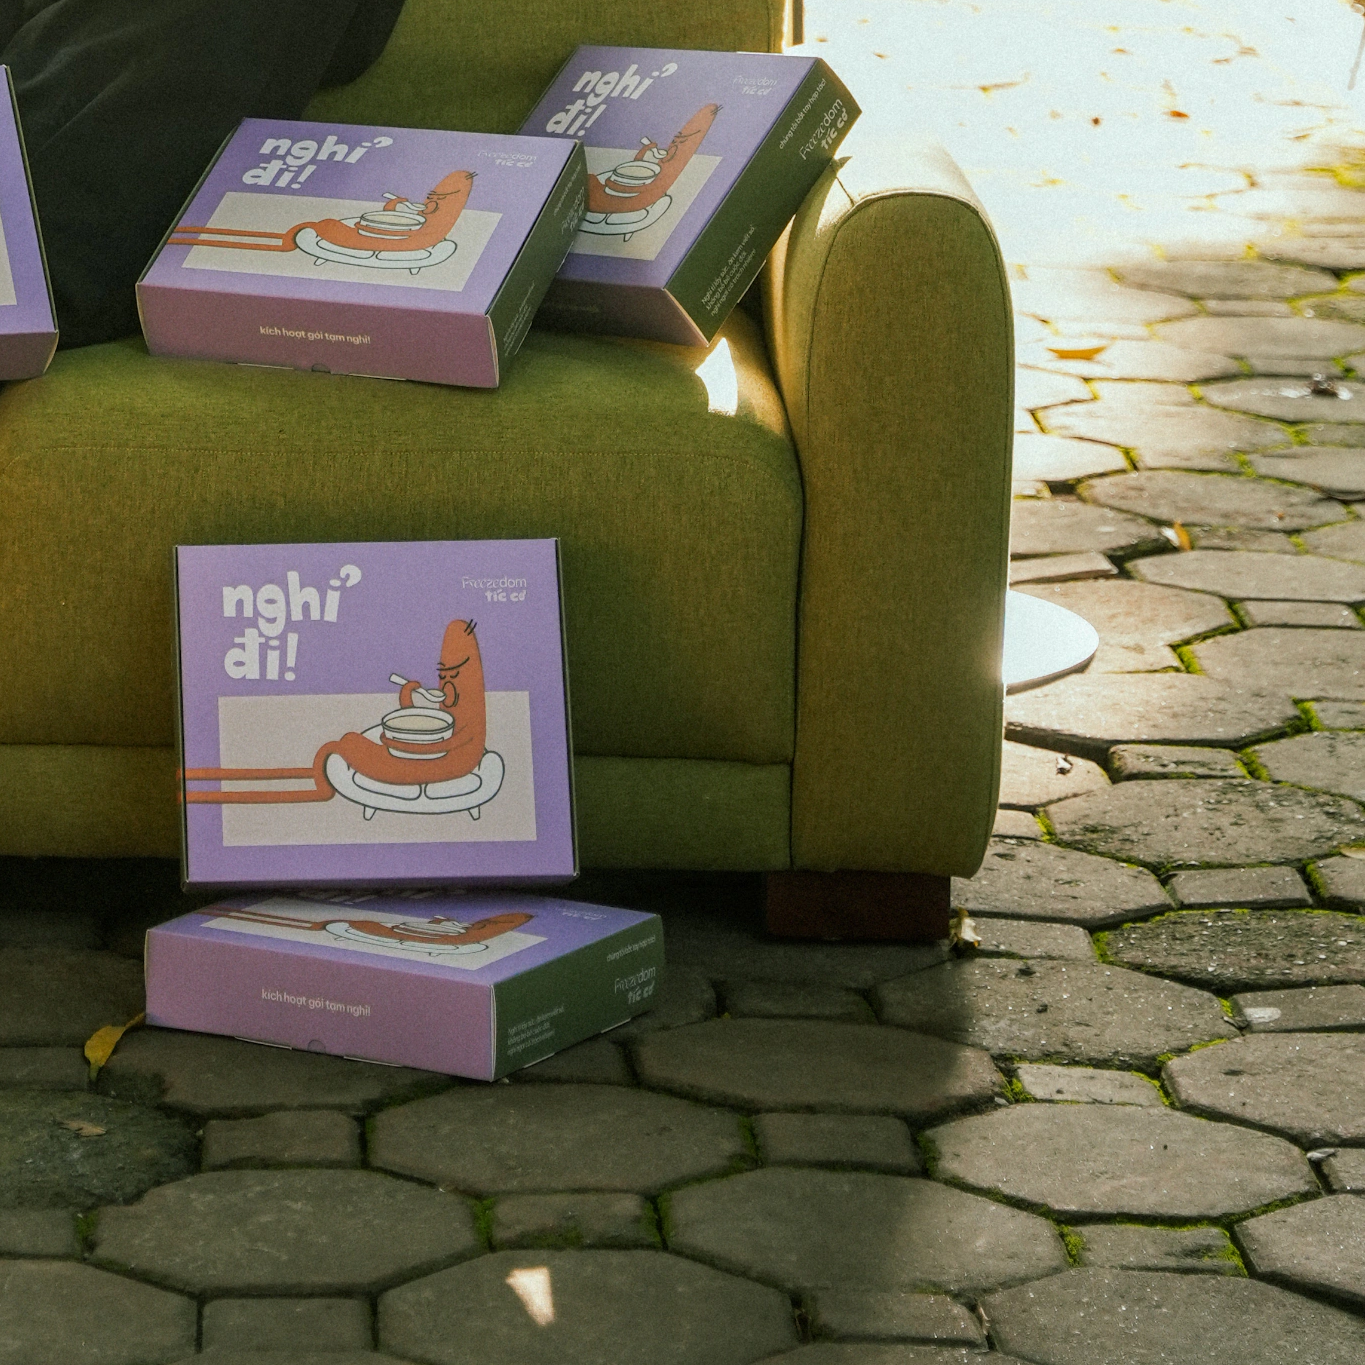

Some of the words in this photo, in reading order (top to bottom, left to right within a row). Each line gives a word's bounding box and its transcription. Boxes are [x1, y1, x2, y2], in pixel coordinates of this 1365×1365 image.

[572, 62, 678, 107] nghỉ
[546, 99, 607, 136] đi!
[259, 135, 394, 166] nghỉ
[242, 159, 317, 189] đi!
[223, 564, 362, 637] nghỉ
[224, 628, 298, 681] đi!
